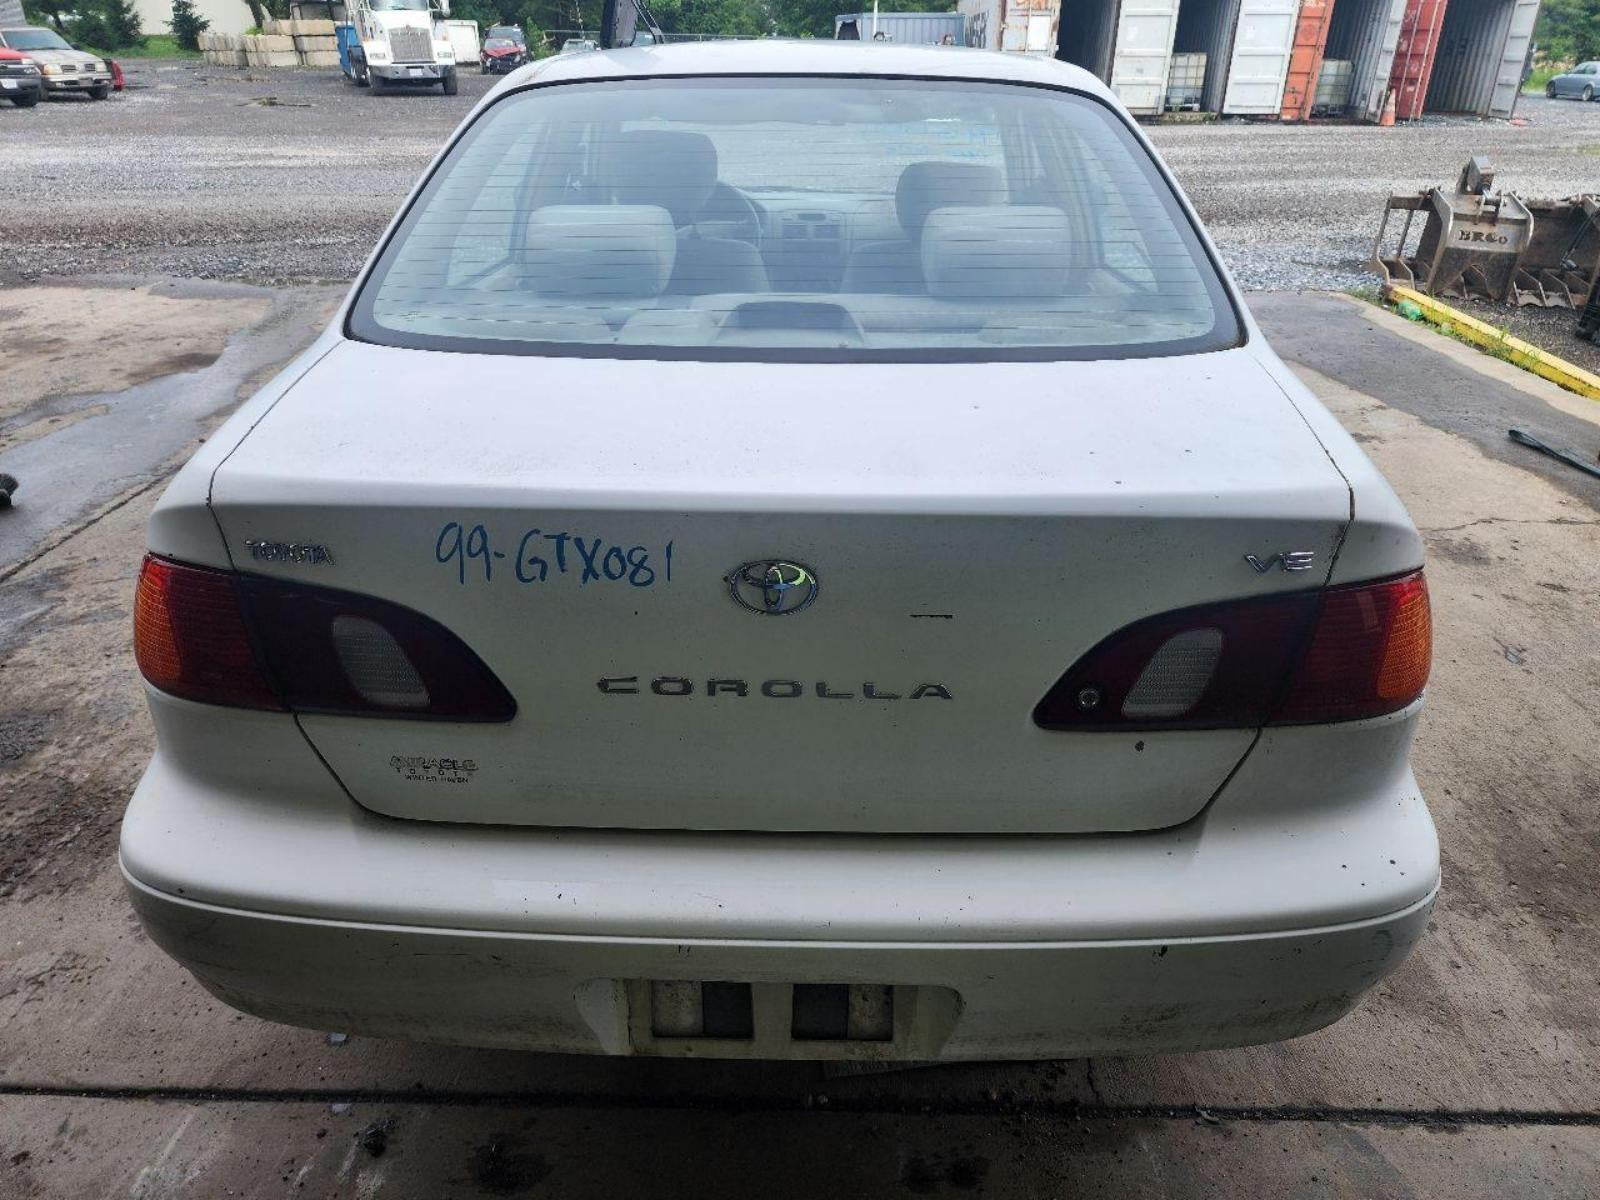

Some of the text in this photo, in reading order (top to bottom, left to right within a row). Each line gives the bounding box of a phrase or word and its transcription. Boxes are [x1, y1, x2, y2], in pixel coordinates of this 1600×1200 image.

[244, 539, 336, 566] TOYOTA
[435, 521, 673, 587] 99-GTX081
[1243, 551, 1314, 574] VE
[597, 675, 953, 700] COROLLA
